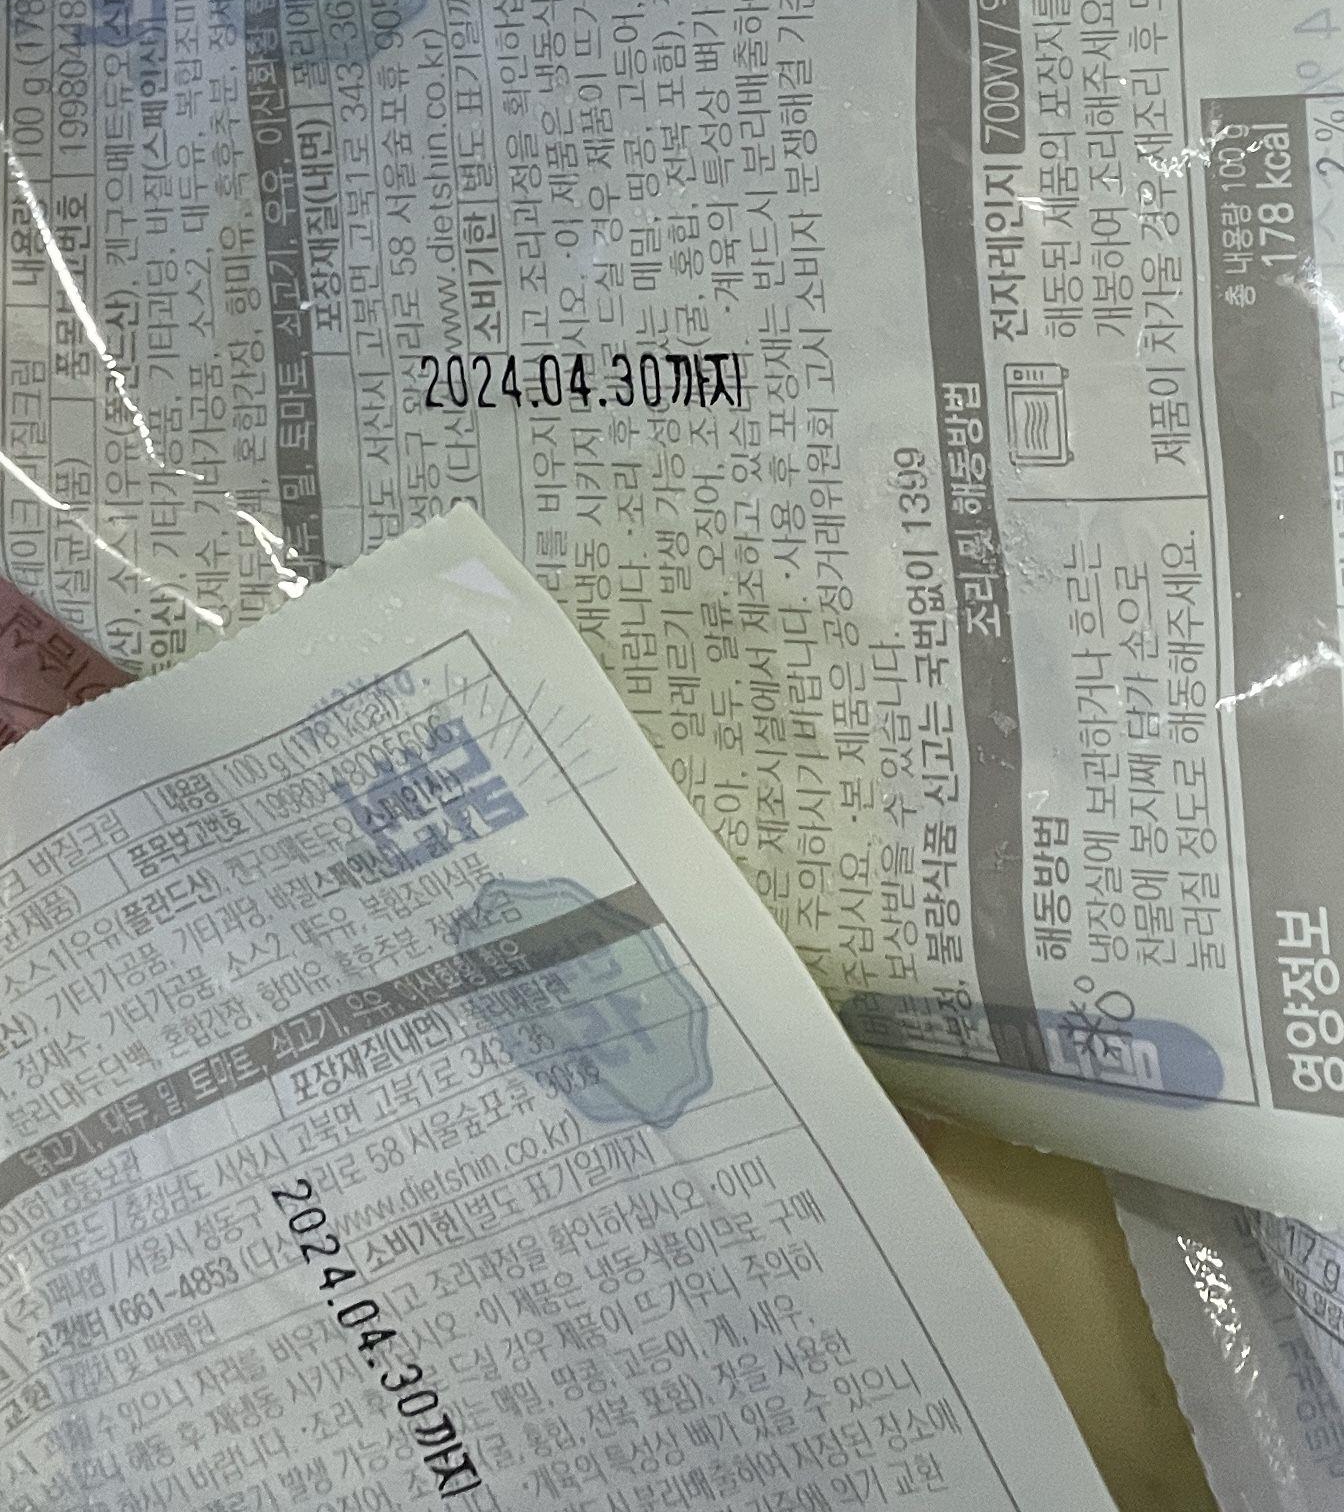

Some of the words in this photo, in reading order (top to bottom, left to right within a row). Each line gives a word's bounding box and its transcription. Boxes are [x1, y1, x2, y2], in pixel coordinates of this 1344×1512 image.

[691, 9, 725, 73] 뼈가
[12, 106, 52, 161] 100
[578, 72, 615, 169] 제품이
[698, 89, 735, 187] 특성상
[779, 59, 820, 194] 분쟁해결
[983, 44, 1020, 142] 700W
[415, 28, 465, 356] www.dietshin.co.kr)
[459, 140, 493, 192] 별도
[544, 108, 579, 203] 제품은
[1252, 123, 1291, 189] kcal
[388, 235, 417, 276] 58
[507, 133, 548, 292] 조리과정을
[746, 190, 786, 290] 반드시
[984, 165, 1029, 340] 전자레인지
[1257, 202, 1297, 267] 178
[464, 214, 502, 341] 소비기한
[420, 354, 744, 410] 2024.04.30까지
[893, 447, 931, 533] 1399
[944, 382, 985, 515] 해동방법
[656, 529, 691, 594] 발생
[807, 407, 860, 647] 공정거래위원회
[903, 550, 948, 687] 국번없이
[1064, 543, 1105, 638] 흐르는
[662, 609, 705, 741] 알레르기
[919, 702, 959, 805] 신고는
[1072, 652, 1116, 814] 보관하거나
[1127, 752, 1169, 854] 봉지째
[1083, 830, 1127, 964] 냉장실에
[1131, 869, 1177, 965] 찬물에
[1179, 871, 1226, 970] 눌러질
[272, 1179, 480, 1497] 2024.04.30까지
